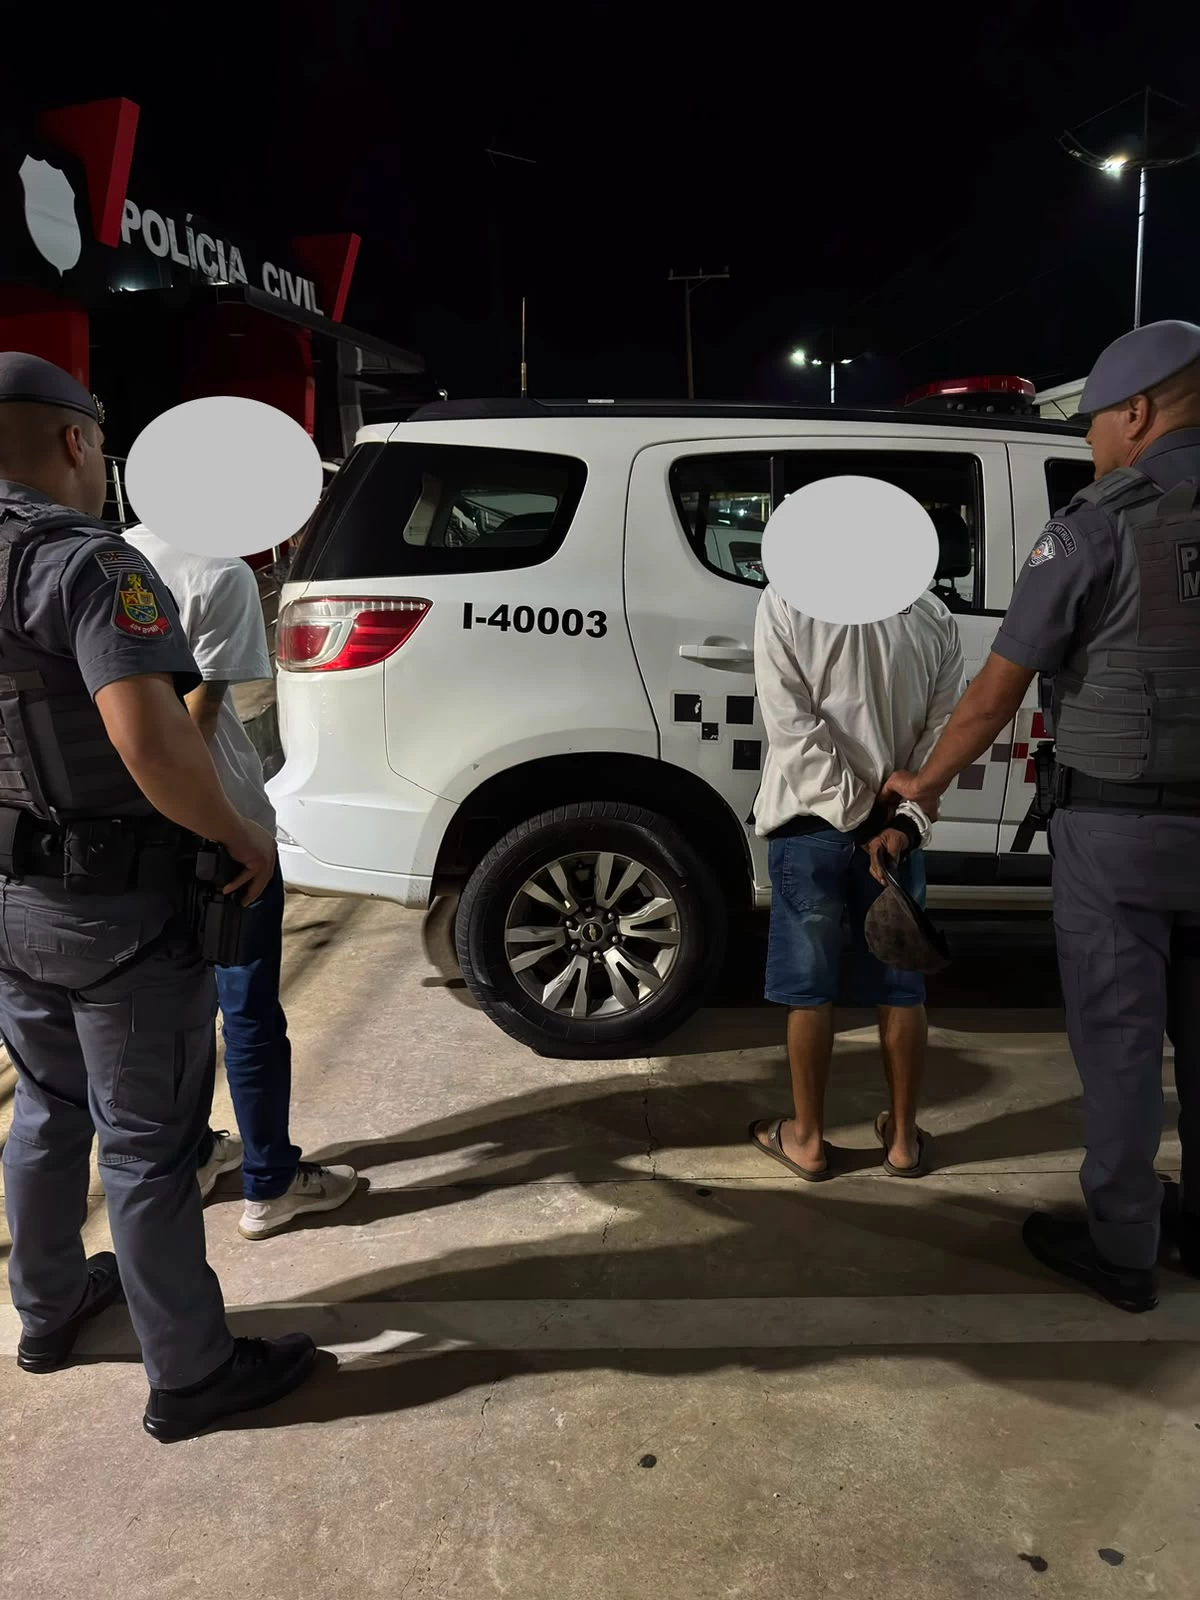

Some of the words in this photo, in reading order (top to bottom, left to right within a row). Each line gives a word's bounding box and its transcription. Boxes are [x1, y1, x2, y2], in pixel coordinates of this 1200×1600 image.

[121, 199, 248, 284] POLÍCIA
[262, 262, 324, 316] CIVIL
[463, 602, 608, 638] I-40003
